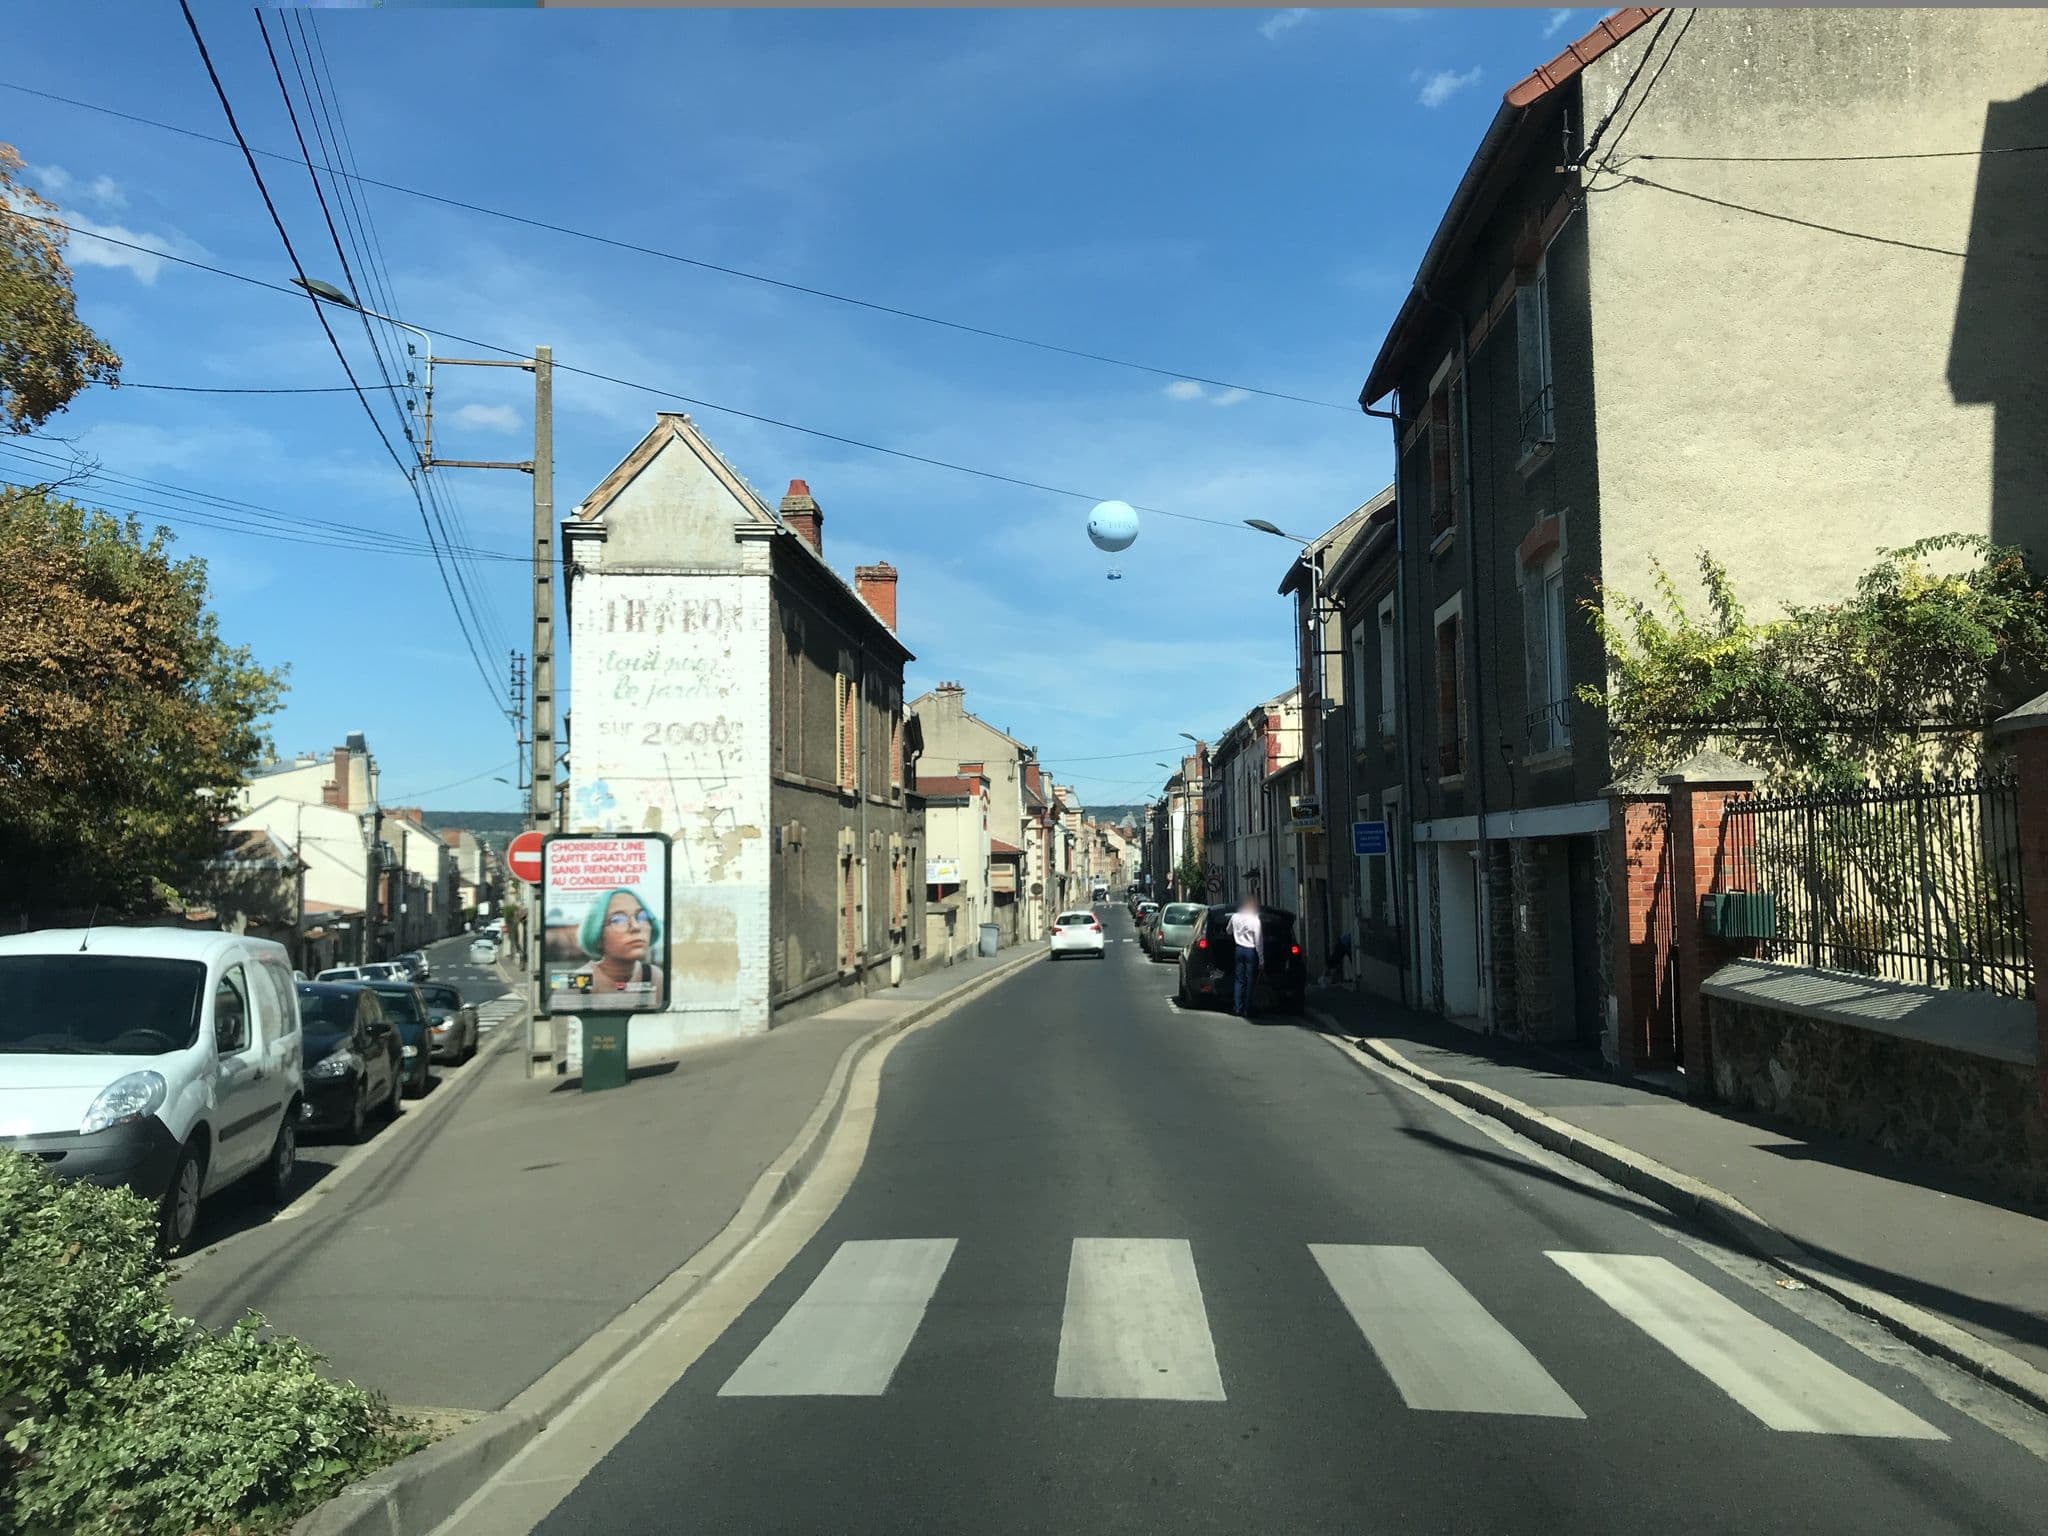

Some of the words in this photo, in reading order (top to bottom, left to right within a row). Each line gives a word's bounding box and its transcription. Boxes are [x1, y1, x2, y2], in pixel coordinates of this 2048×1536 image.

[598, 720, 633, 737] sur
[551, 841, 618, 852] CHOISISSEZ
[621, 841, 645, 851] UNE
[551, 853, 587, 863] CARTE
[591, 852, 647, 862] GRATUITE
[551, 865, 581, 875] SANS
[584, 863, 648, 874] RENONCER
[551, 876, 567, 886] AU
[569, 875, 641, 886] CONSEILLER
